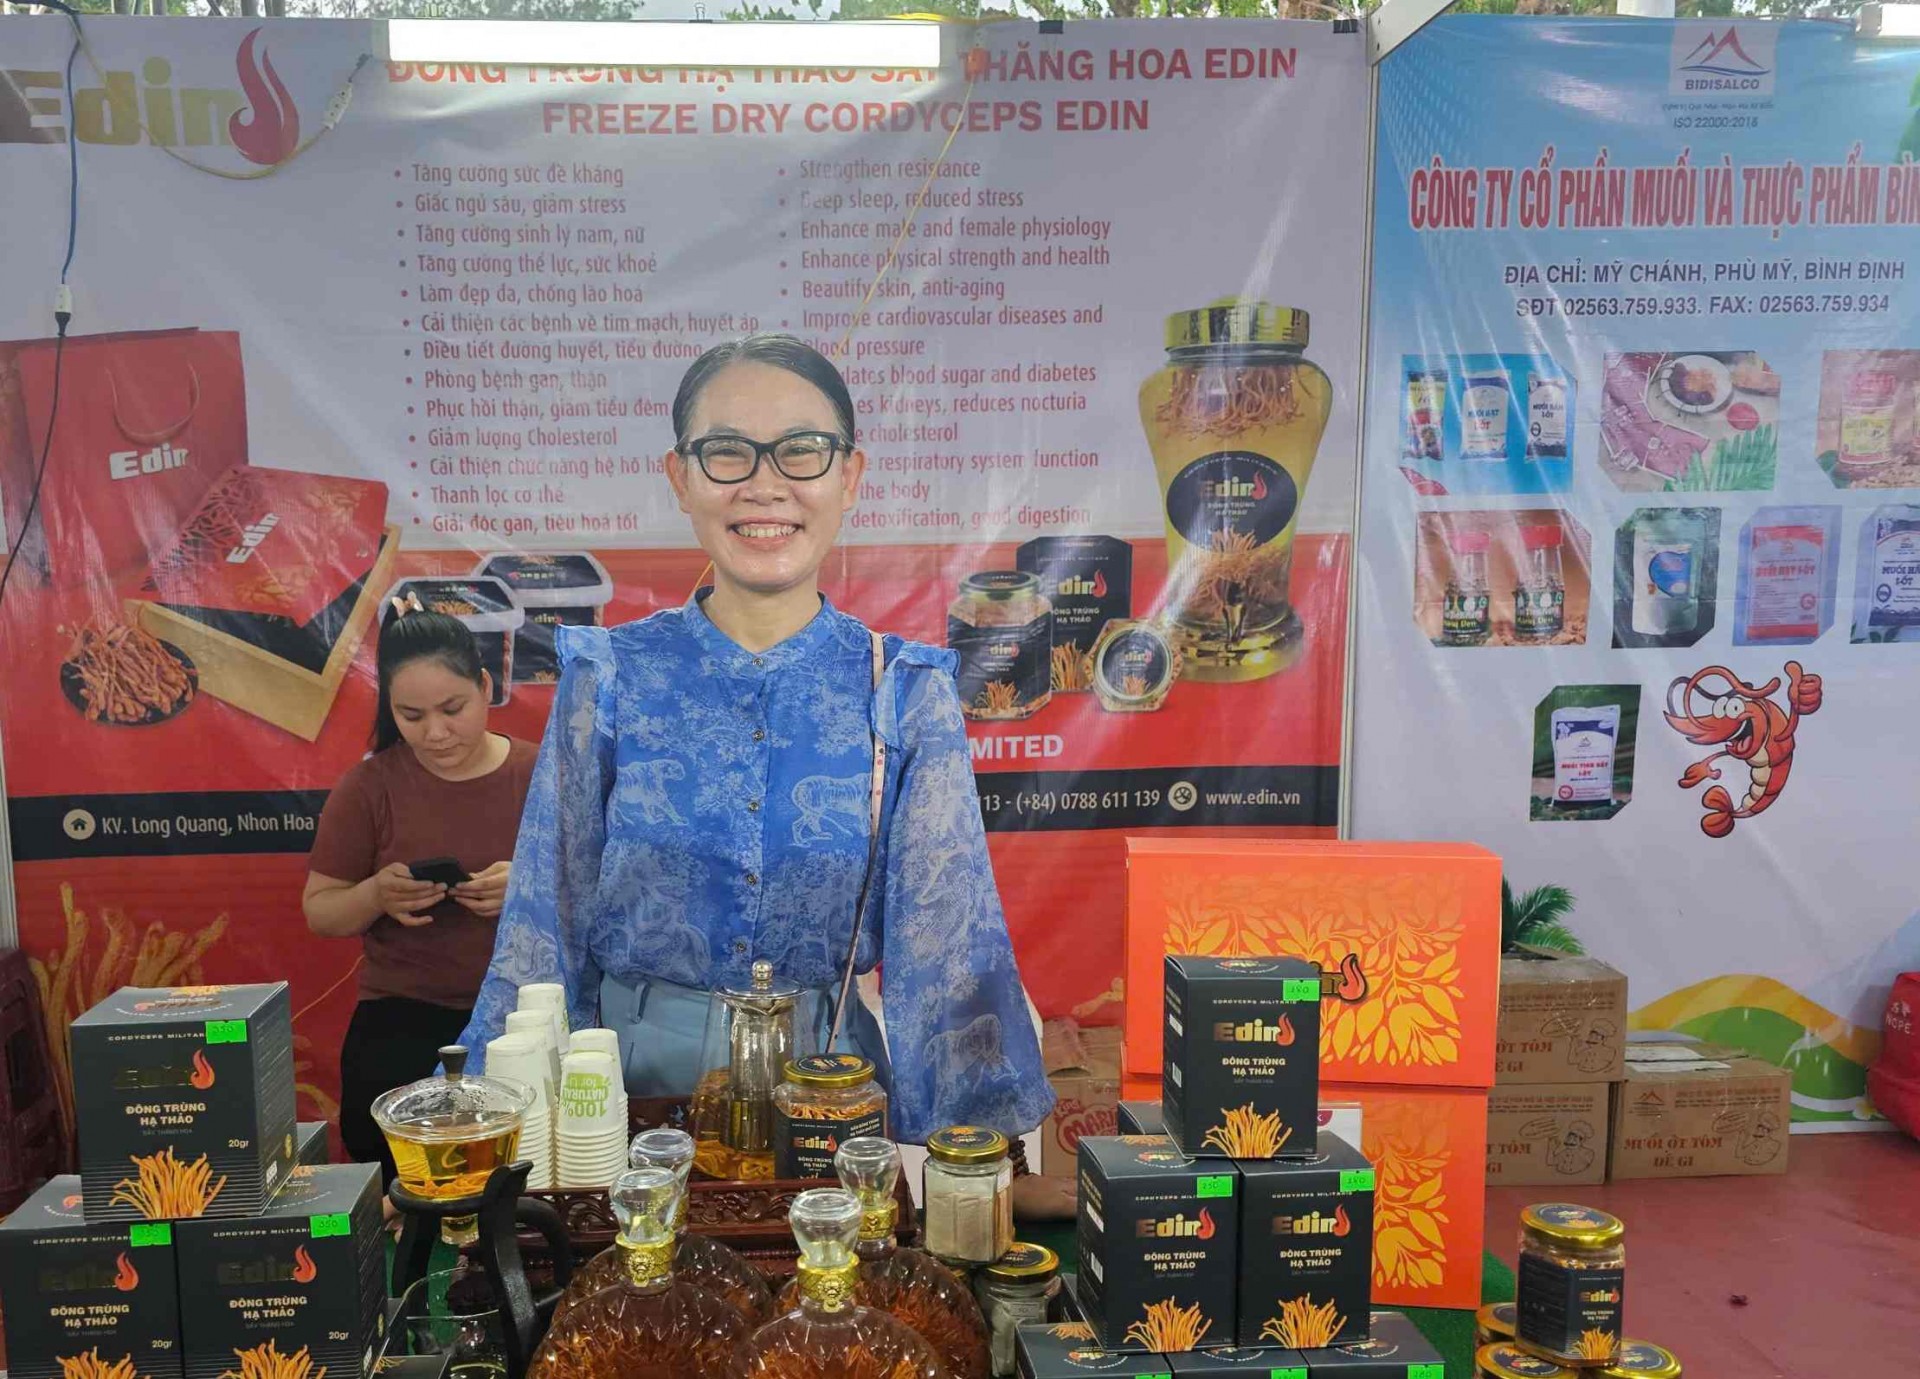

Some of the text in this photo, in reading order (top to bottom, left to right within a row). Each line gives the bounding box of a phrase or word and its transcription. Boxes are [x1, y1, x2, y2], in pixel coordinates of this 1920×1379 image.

[1109, 48, 1192, 80] HOA
[1204, 47, 1297, 79] EDIN
[1685, 78, 1760, 90] BIDISALCO
[543, 100, 1149, 134] FREEZE DRY CORDYCEPS EDIN
[1673, 117, 1690, 128] ISO
[799, 159, 981, 184] Strengthen resistance
[1410, 156, 1478, 229] CÔNG
[1485, 169, 1514, 228] TY
[1519, 146, 1554, 228] CỔ
[1558, 148, 1626, 228] PHẦN
[1631, 147, 1697, 227] MUỐI
[1704, 154, 1733, 226] VÀ
[1742, 160, 1804, 239] THỰC
[1809, 141, 1880, 225] PHẨM
[579, 196, 626, 213] stress
[850, 188, 898, 213] sleep,
[906, 187, 971, 207] reduced
[977, 188, 1024, 207] stress
[517, 223, 550, 243] sinh
[577, 228, 618, 246] nam,
[801, 216, 1111, 241] Enhance male and female physiology
[802, 245, 1110, 273] Enhance physical strength and health
[1505, 257, 1905, 287] ĐỊA CHỈ: MỸ CHÁNH, PHÙ MỸ, BÌNH ĐỊNH
[460, 283, 490, 306] đẹp
[803, 279, 1005, 303] Beautify skin, anti-aging
[1564, 296, 1702, 315] 02563.759.933.
[1709, 295, 1752, 314] FAX:
[1759, 294, 1889, 313] 02563.759.934
[604, 313, 629, 332] tim
[803, 305, 1103, 331] Improve cardiovascular diseases and
[857, 338, 925, 360] pressure
[529, 373, 564, 393] gan,
[891, 363, 1096, 388] blood sugar and diabetes
[880, 394, 947, 417] kidneys,
[953, 393, 1015, 412] reduces
[1021, 391, 1087, 412] nocturia
[528, 427, 617, 446] Cholesterol
[869, 422, 958, 442] cholesterol
[109, 442, 189, 480] Edin
[878, 449, 1099, 474] respiratory system function
[431, 485, 479, 504] Thanh
[860, 480, 930, 502] the body
[504, 517, 538, 536] gan,
[851, 505, 1091, 529] detoxification, good digestion
[226, 512, 281, 564] Edin
[977, 789, 1301, 815] 13 (+84) 0788 611 139 www.edin.vn
[102, 812, 314, 838] KV. Long Quang, Nhon Hoa
[1213, 1018, 1281, 1042] Edin
[1222, 1056, 1286, 1066] ĐÔNG TRÙNG
[1232, 1066, 1275, 1077] HẠ THẢO
[563, 1088, 605, 1101] NATURAL
[125, 1102, 206, 1114] ĐÔNG TRÙNG
[561, 1100, 608, 1118] 100%
[140, 1112, 193, 1127] HẠ THẢO
[228, 1138, 249, 1149] 20gr
[793, 1136, 830, 1150] Edin
[1678, 1156, 1695, 1167] GI
[1136, 1213, 1202, 1238] Edin
[1272, 1210, 1337, 1235] Edin
[33, 1237, 88, 1245] CORDYCEPS
[213, 1229, 267, 1238] CORDYCEPS
[1144, 1250, 1206, 1261] ĐÔNG TRÙNG
[1280, 1248, 1342, 1259] ĐÔNG TRÙNG
[1154, 1260, 1196, 1272] HẠ THẢO
[1290, 1258, 1332, 1270] HẠ THẢO
[50, 1303, 130, 1317] ĐÔNG TRÙNG
[229, 1295, 307, 1309] ĐÔNG TRÙNG
[64, 1314, 118, 1329] HẠ THẢO
[243, 1306, 295, 1321] HẠ THẢO
[152, 1339, 173, 1350] 20gr
[328, 1331, 350, 1341] 20gr
